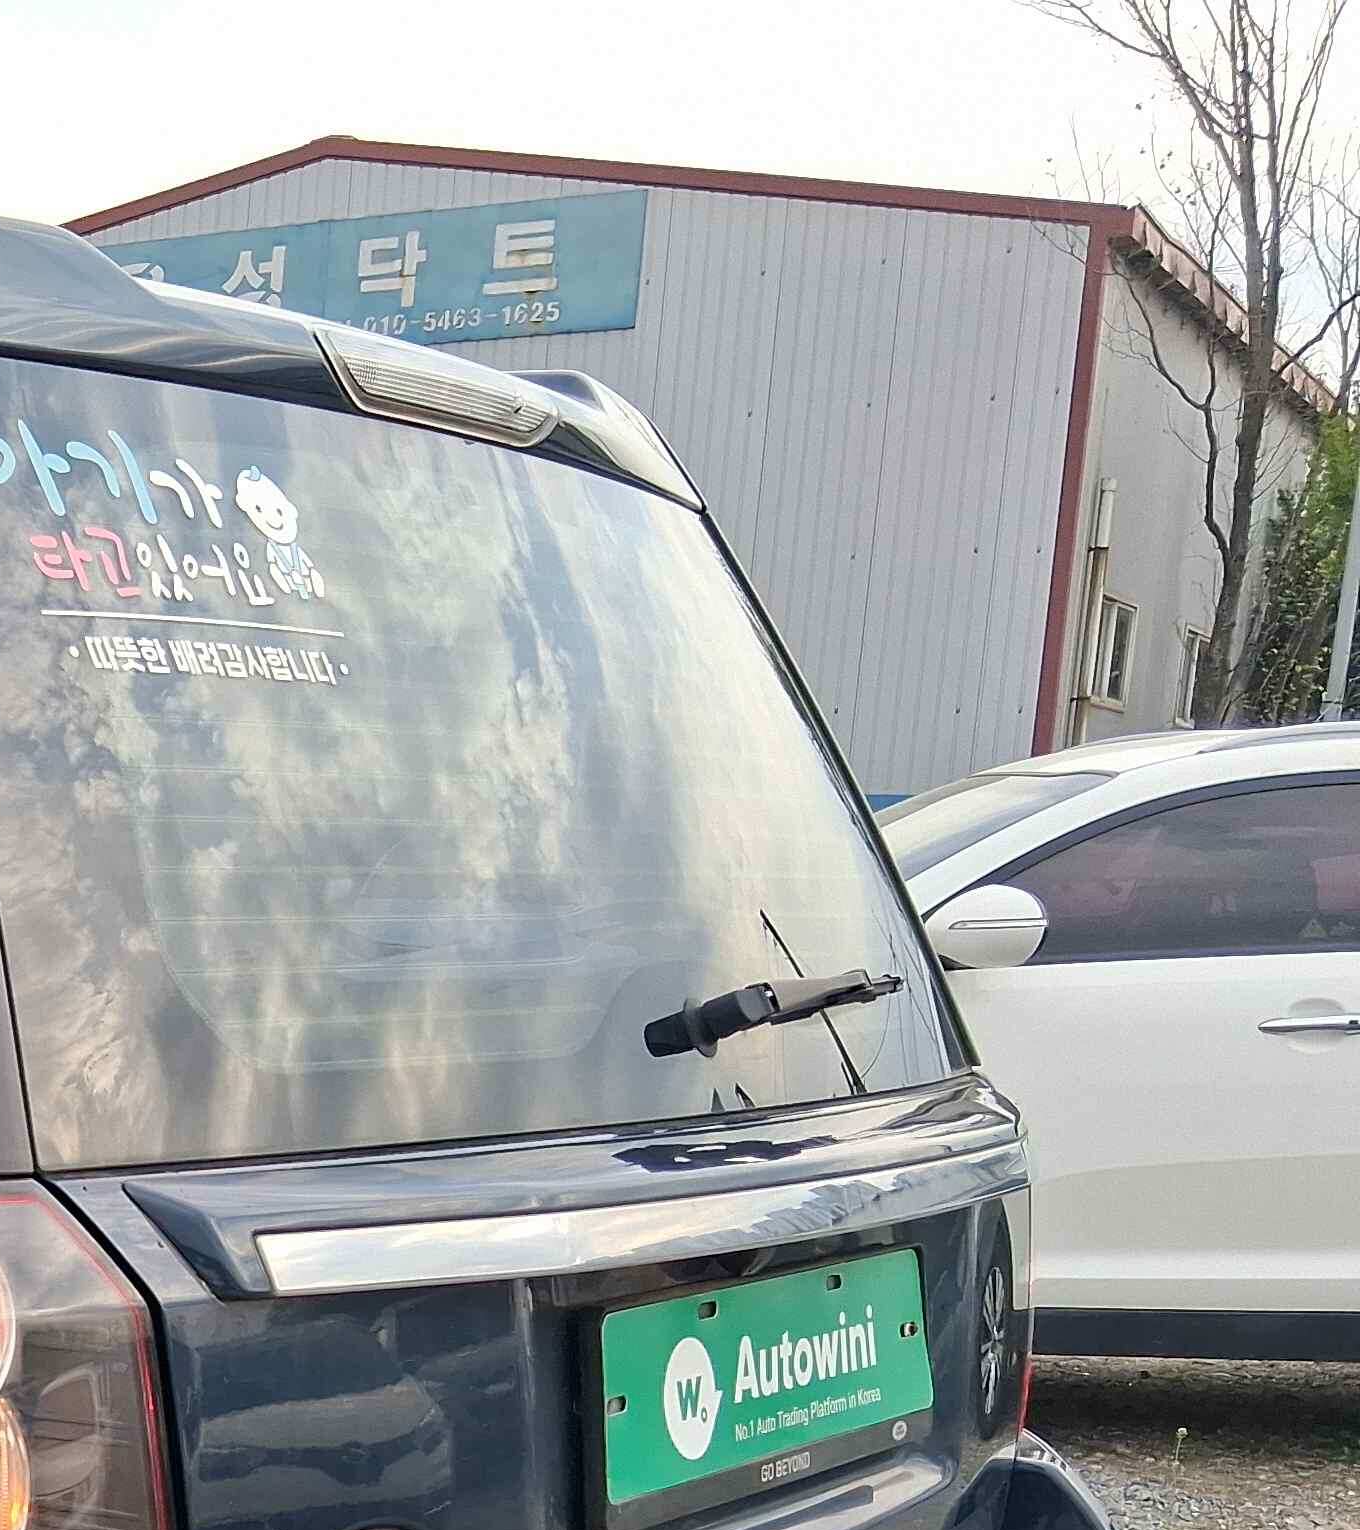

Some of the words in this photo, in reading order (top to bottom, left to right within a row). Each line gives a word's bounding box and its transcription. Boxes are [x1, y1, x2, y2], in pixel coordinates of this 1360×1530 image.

[119, 217, 558, 308] 성닥트
[733, 1304, 877, 1403] Autowini
[735, 1419, 754, 1442] No.1
[757, 1415, 776, 1434] Auto
[777, 1406, 809, 1428] Trading
[810, 1395, 848, 1419] Platform
[848, 1393, 857, 1410] in
[857, 1387, 882, 1406] Korea
[761, 1463, 774, 1482] GO
